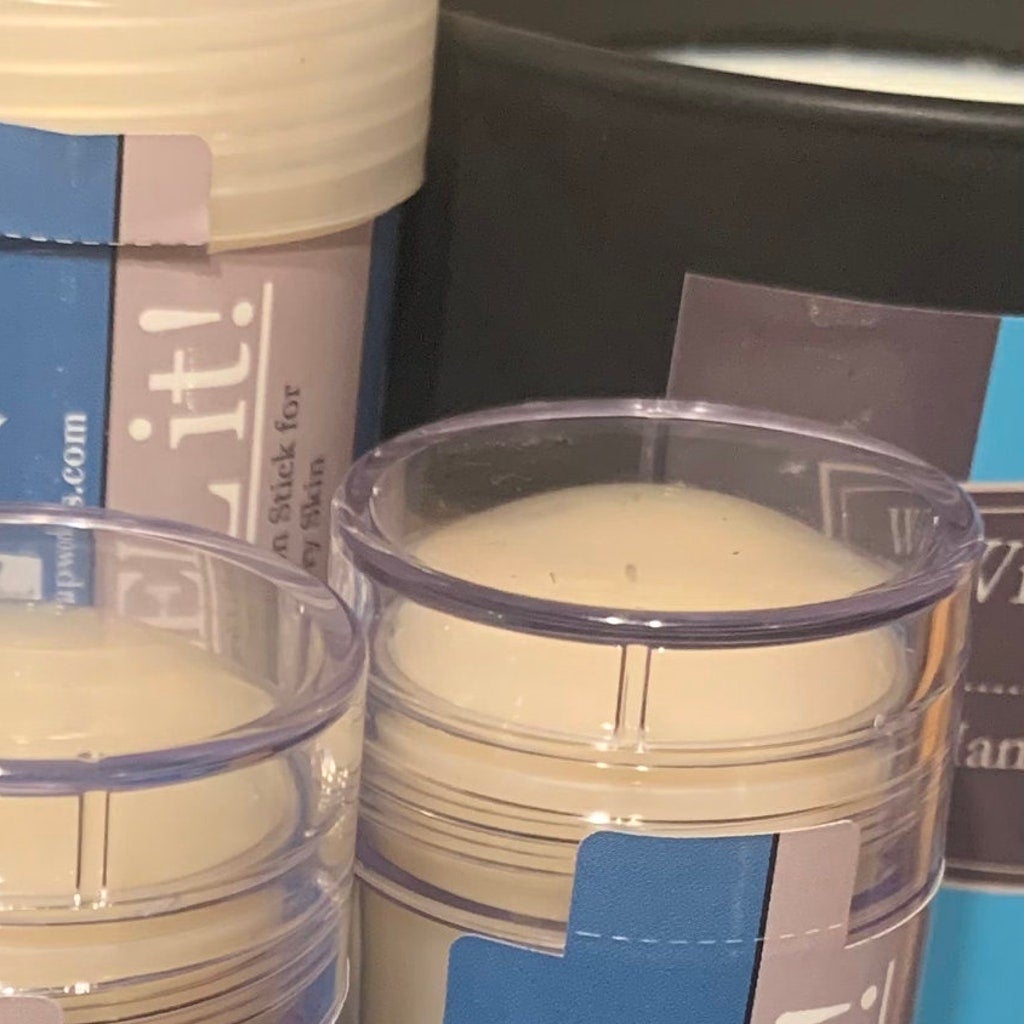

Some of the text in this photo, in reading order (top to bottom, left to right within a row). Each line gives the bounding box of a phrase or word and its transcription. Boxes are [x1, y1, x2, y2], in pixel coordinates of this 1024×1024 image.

[127, 298, 255, 450] it!
[273, 384, 301, 434] for
[269, 440, 296, 525] Stick
[299, 457, 325, 530] Skin
